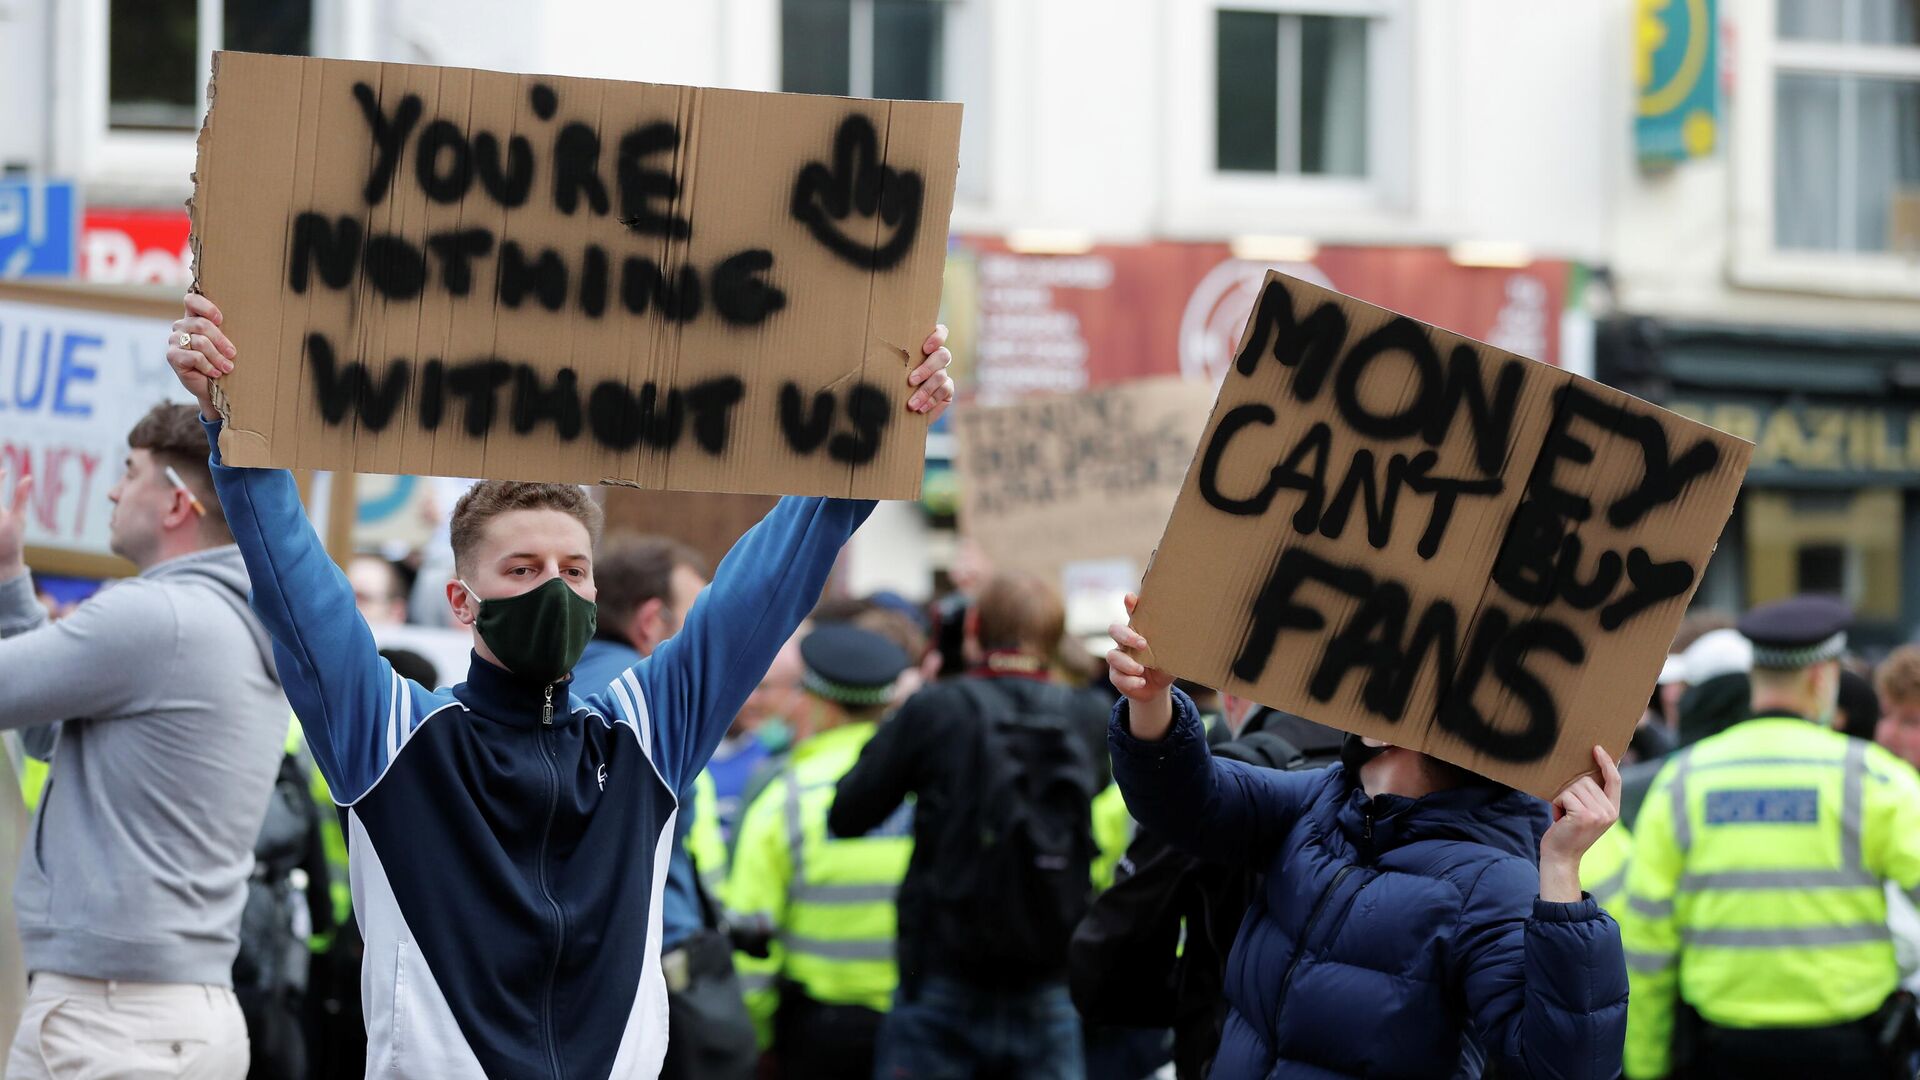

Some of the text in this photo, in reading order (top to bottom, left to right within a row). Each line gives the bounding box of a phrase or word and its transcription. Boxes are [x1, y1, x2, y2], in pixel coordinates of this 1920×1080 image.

[289, 208, 786, 331] NOTHING
[304, 333, 746, 458] WITHOUT
[778, 380, 890, 472] US
[1236, 279, 1721, 530] MONEY
[1199, 402, 1506, 560] CAN'T
[1490, 500, 1696, 633] BUY
[1232, 545, 1587, 767] FANS
[1710, 793, 1815, 821] POLICE
